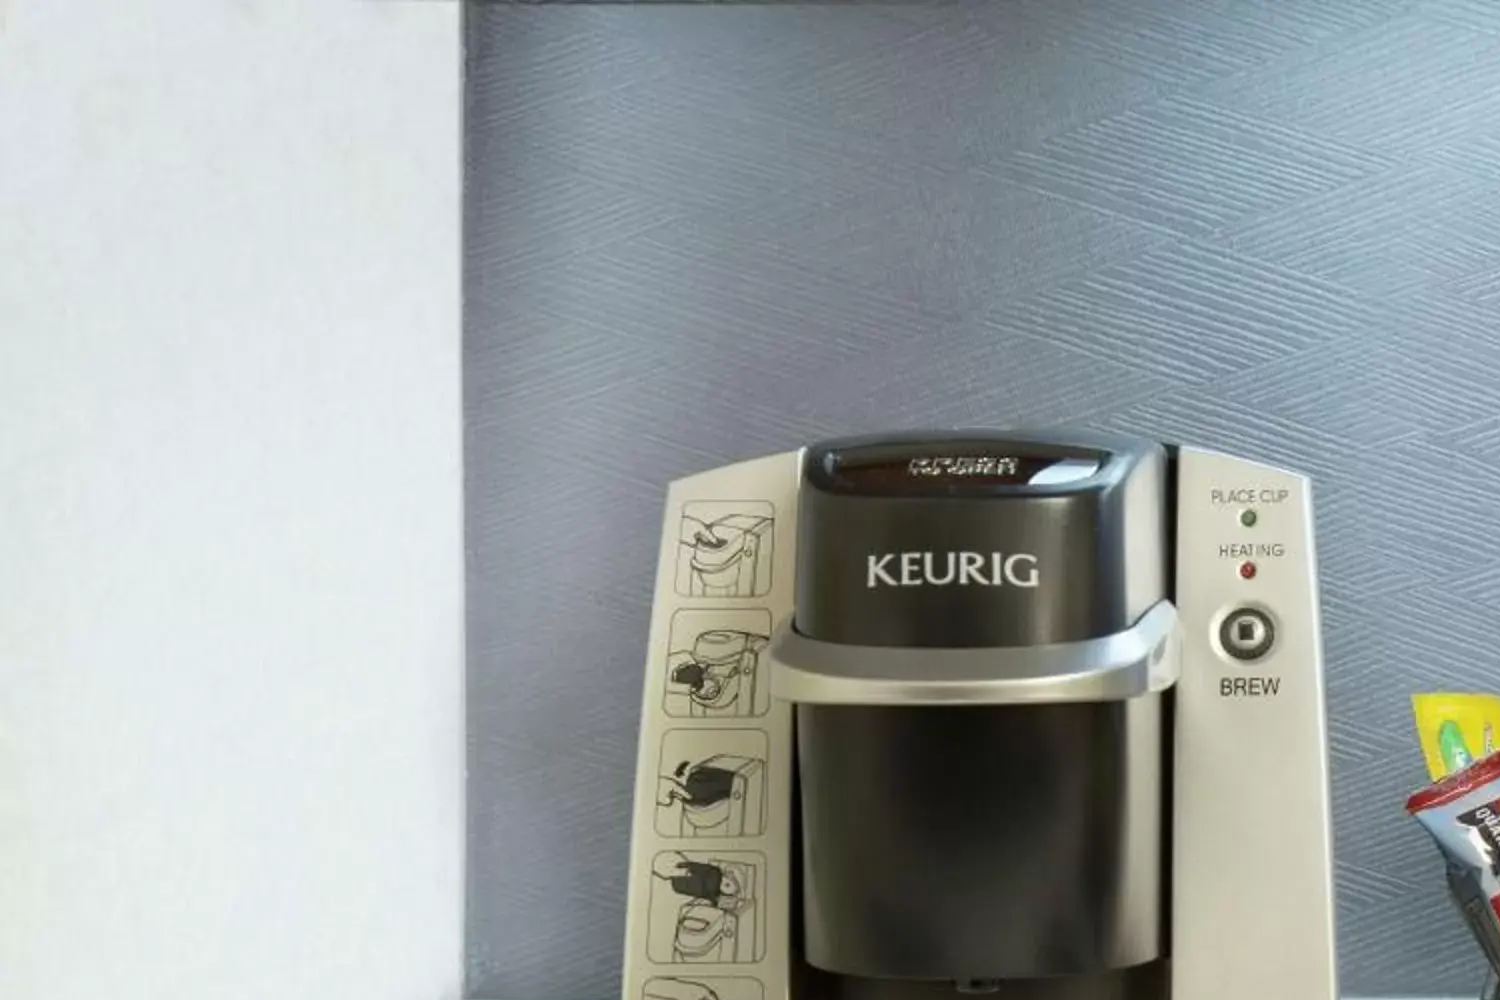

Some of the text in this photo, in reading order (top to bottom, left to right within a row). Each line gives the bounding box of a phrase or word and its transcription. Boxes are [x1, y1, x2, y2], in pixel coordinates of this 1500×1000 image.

[1210, 489, 1289, 503] PLACE CUP
[1218, 543, 1285, 557] HEATING
[866, 551, 1040, 588] KEURIG
[1219, 677, 1281, 697] BREW
